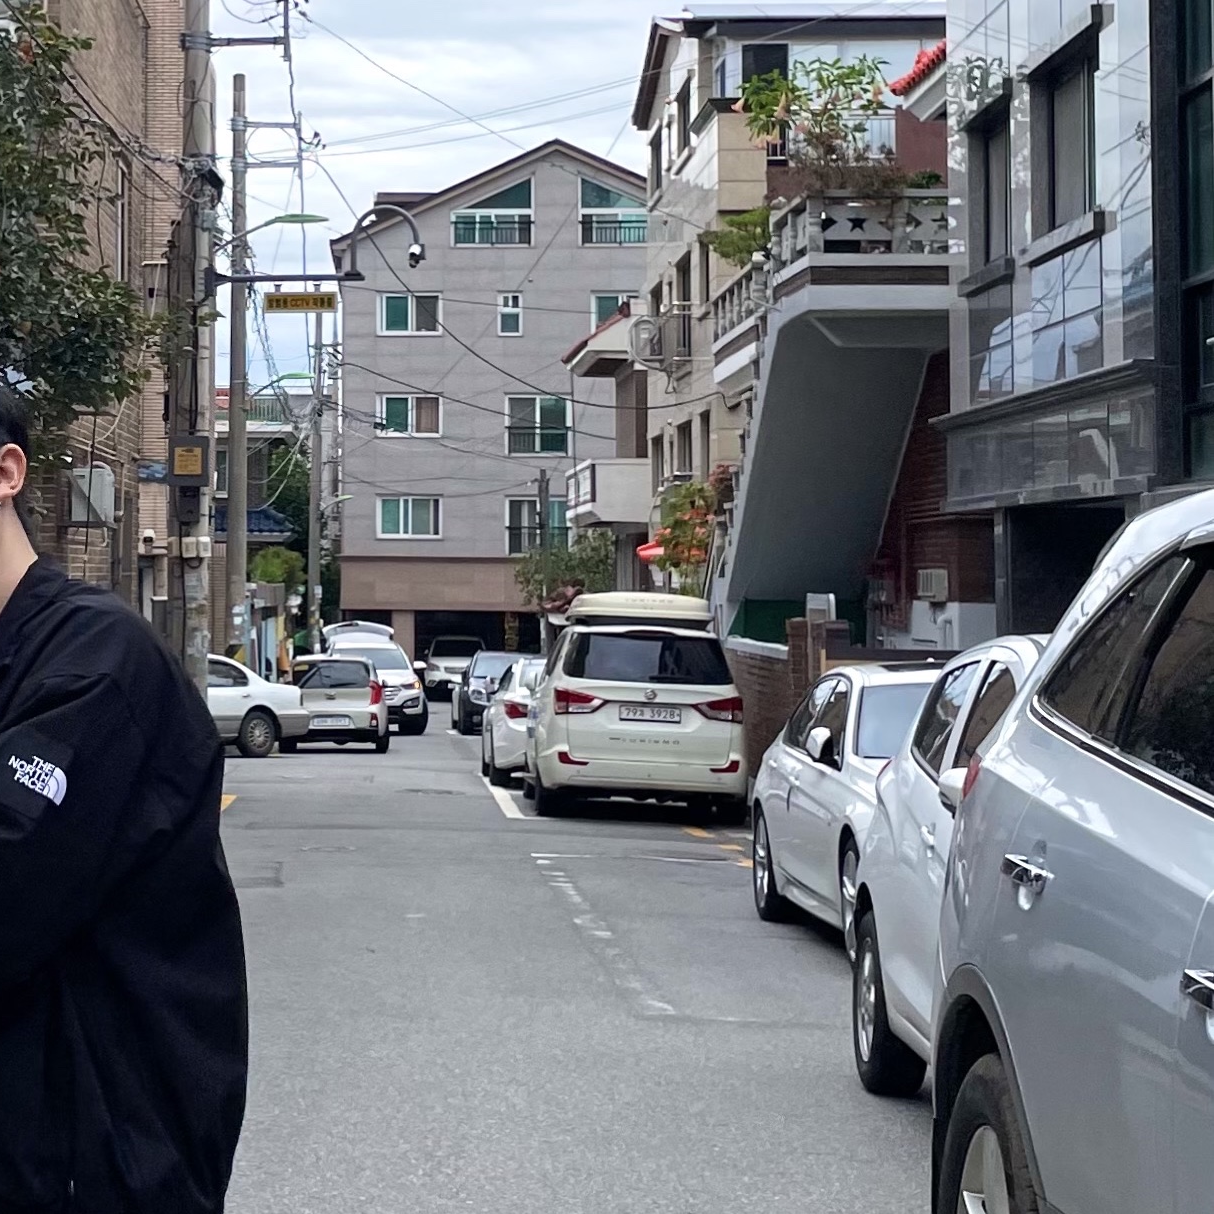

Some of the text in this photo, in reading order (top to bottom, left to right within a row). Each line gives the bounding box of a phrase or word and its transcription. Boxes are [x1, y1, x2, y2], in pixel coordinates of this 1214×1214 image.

[290, 298, 310, 308] CCTV
[650, 708, 676, 720] 3928
[7, 755, 52, 785] NORTH
[31, 755, 56, 773] THE
[14, 770, 47, 793] FACE
